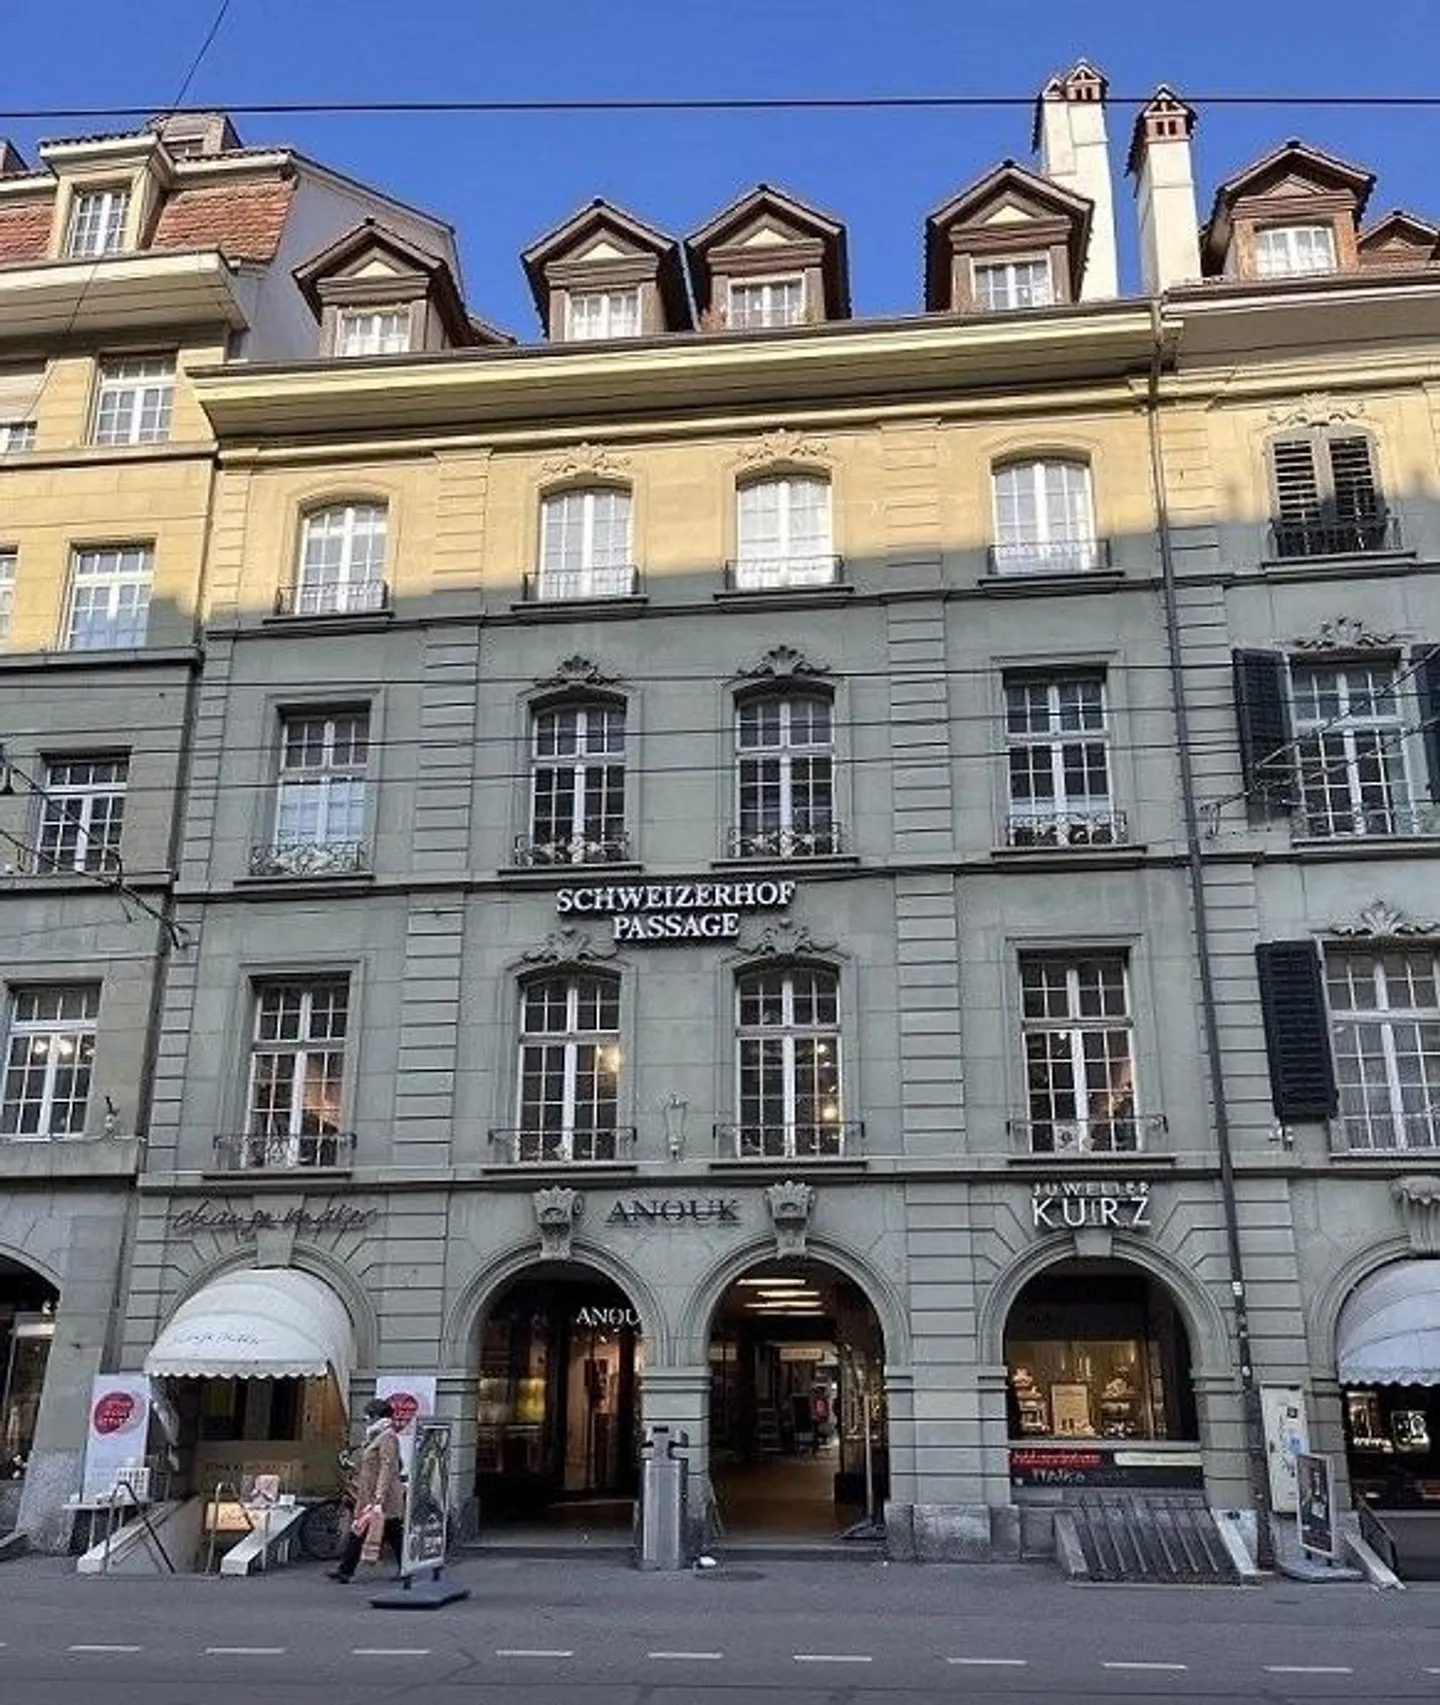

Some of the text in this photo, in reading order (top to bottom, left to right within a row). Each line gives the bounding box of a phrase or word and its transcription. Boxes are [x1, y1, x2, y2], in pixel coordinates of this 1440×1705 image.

[556, 881, 796, 912] SCHWEIZERHOF
[613, 914, 739, 939] PASSAGE
[1033, 1182, 1149, 1196] JUWELIER
[606, 1199, 739, 1222] ANOUK
[1032, 1197, 1151, 1226] KURZ
